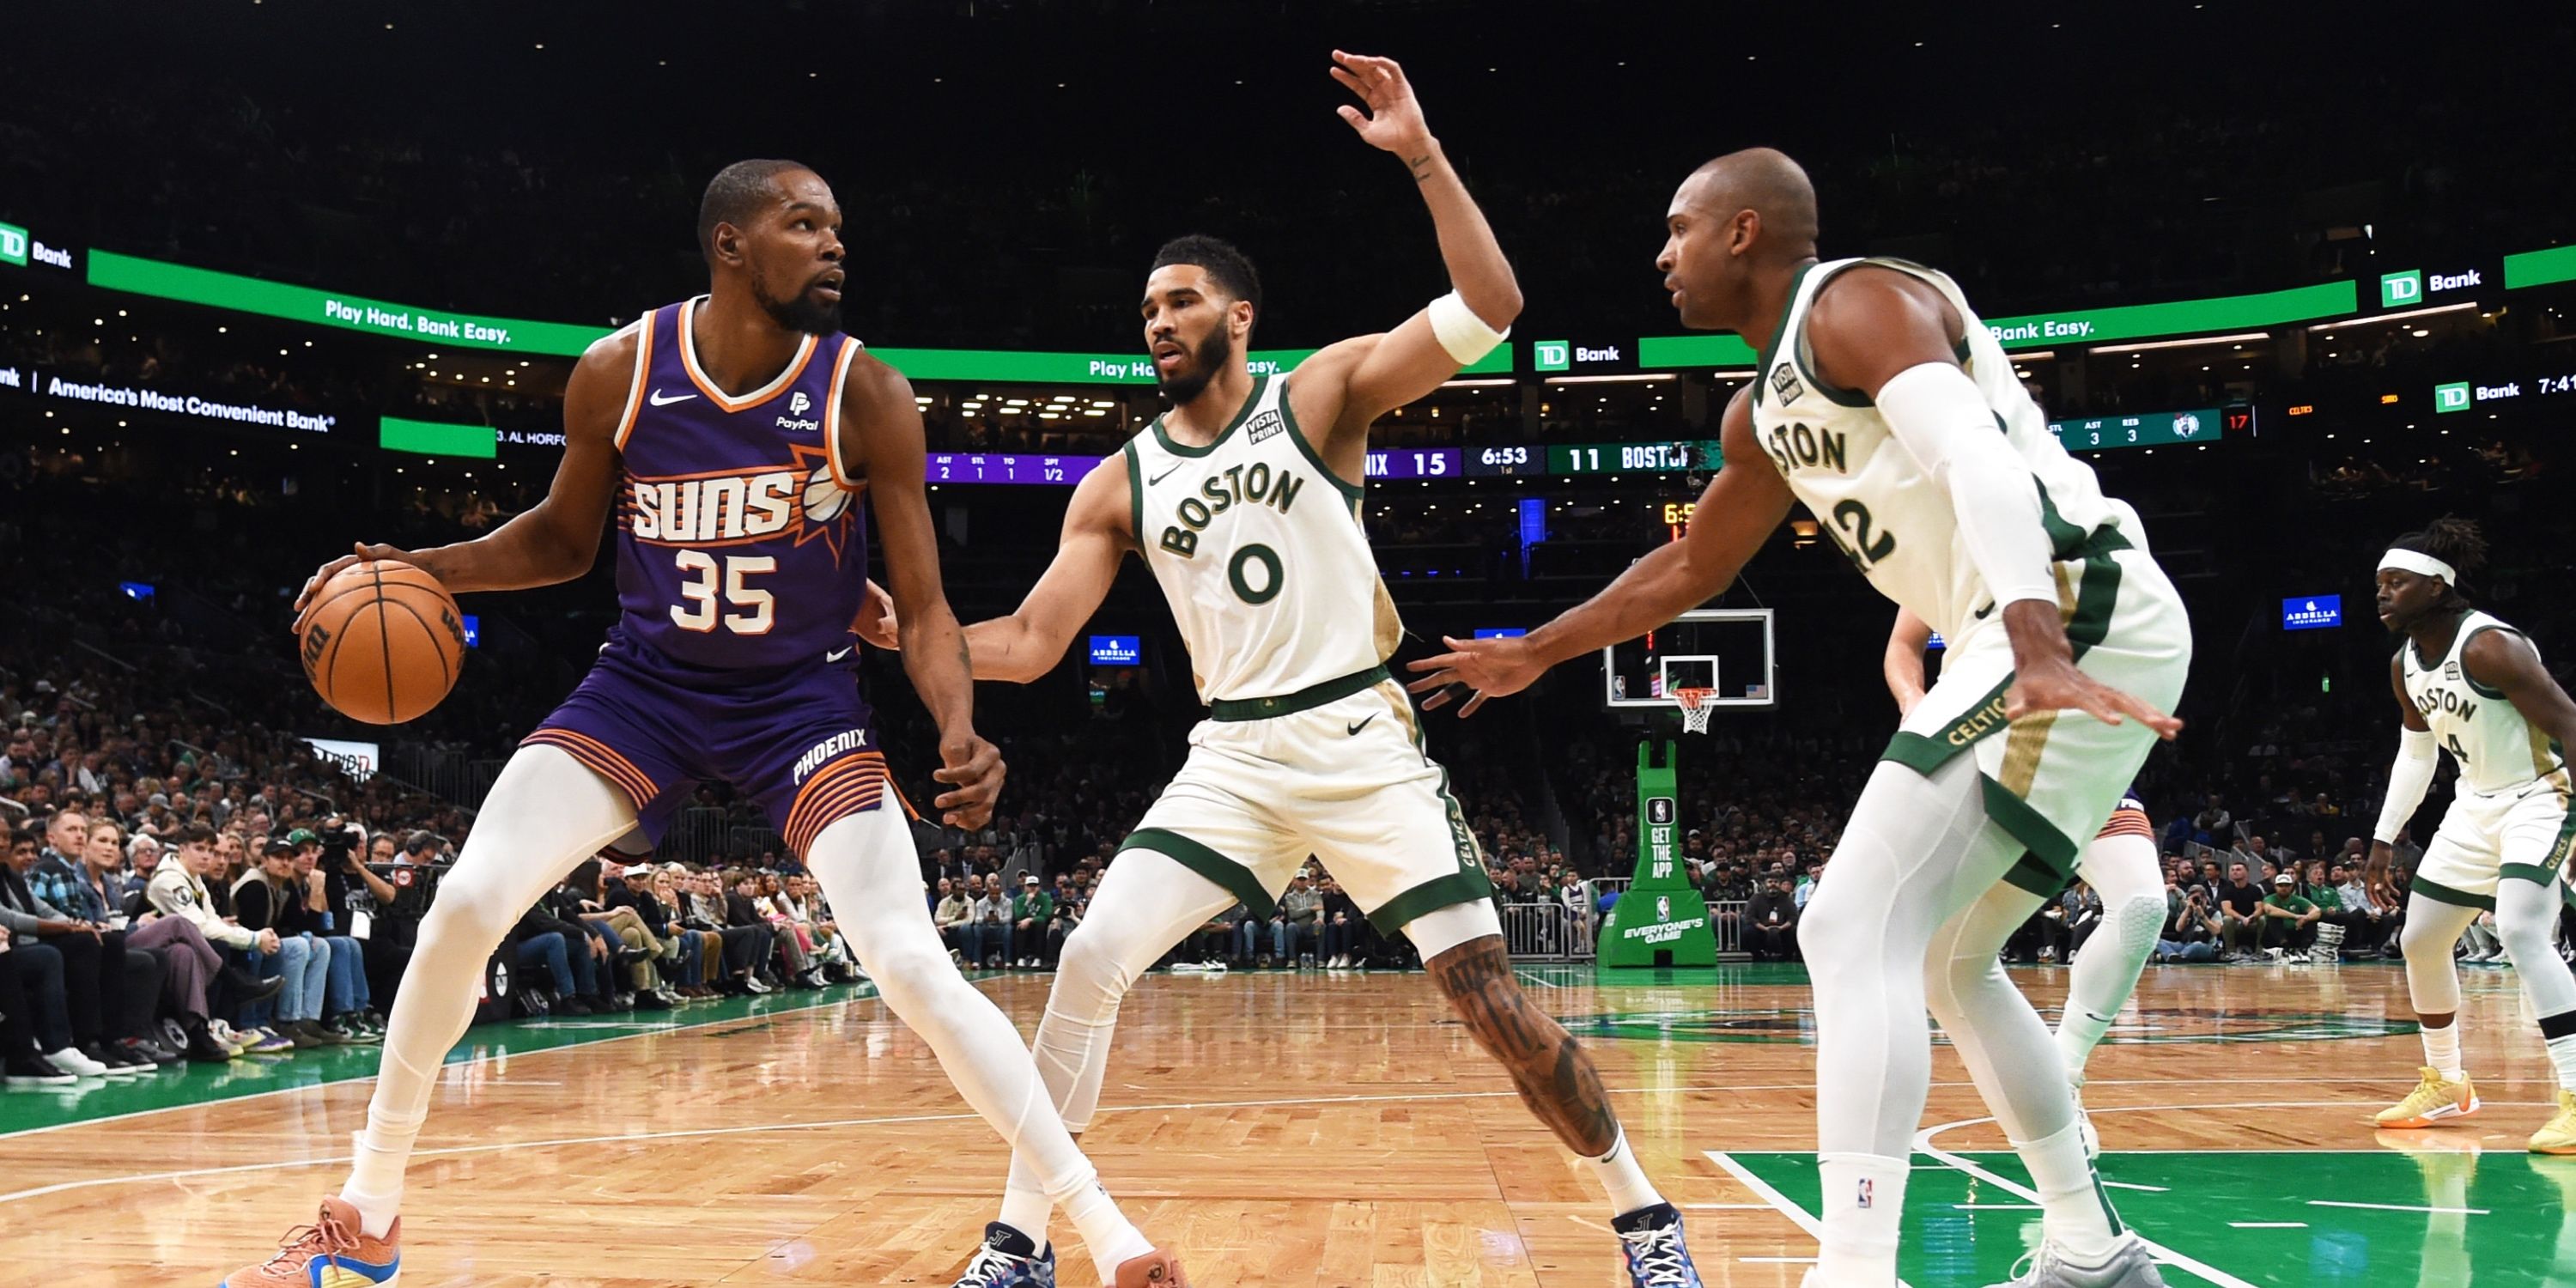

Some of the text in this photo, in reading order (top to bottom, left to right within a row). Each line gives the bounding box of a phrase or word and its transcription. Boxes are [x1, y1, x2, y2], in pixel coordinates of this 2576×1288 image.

[33, 241, 72, 269] Bank
[2385, 270, 2482, 300] TD Bank
[325, 300, 511, 344] Play Hard. Bank Easy.
[1991, 320, 2095, 342] Bank Easy.
[1537, 345, 1619, 365] TD Bank
[0, 368, 20, 387] nk
[1090, 361, 1156, 379] Play Ha
[1247, 361, 1280, 375] asy.
[49, 376, 137, 407] America's
[141, 389, 184, 413] Most
[186, 397, 283, 427] Convenient
[2438, 383, 2519, 407] TD Bank
[776, 416, 818, 431] PayPal
[1247, 410, 1279, 432] VISTA
[2084, 421, 2101, 429] AST
[2229, 415, 2249, 429] 17
[496, 431, 508, 442] 3.
[509, 432, 525, 444] AL
[1250, 422, 1284, 443] PRINT
[2090, 429, 2137, 445] 3 3
[1481, 447, 1528, 465] 6:53
[1769, 422, 1847, 475] STON
[941, 467, 1063, 481] 2 1 1 1/2
[1414, 453, 1447, 475] 15
[634, 471, 794, 541] SUNS
[1160, 461, 1304, 559] BOSTON
[1664, 503, 1696, 524] 6:5
[1824, 499, 1897, 568] 2
[1227, 542, 1285, 605] 0
[670, 549, 777, 635] 35
[1947, 690, 2008, 746] CELTIC
[793, 728, 867, 787] PHOENIX
[2447, 733, 2470, 763] 4
[1651, 828, 1670, 843] GET
[1651, 845, 1672, 860] THE
[2546, 837, 2568, 870] CELTICS
[1652, 862, 1673, 878] APP
[1624, 918, 1704, 939] EVERYONE'S
[1644, 931, 1682, 944] GAME
